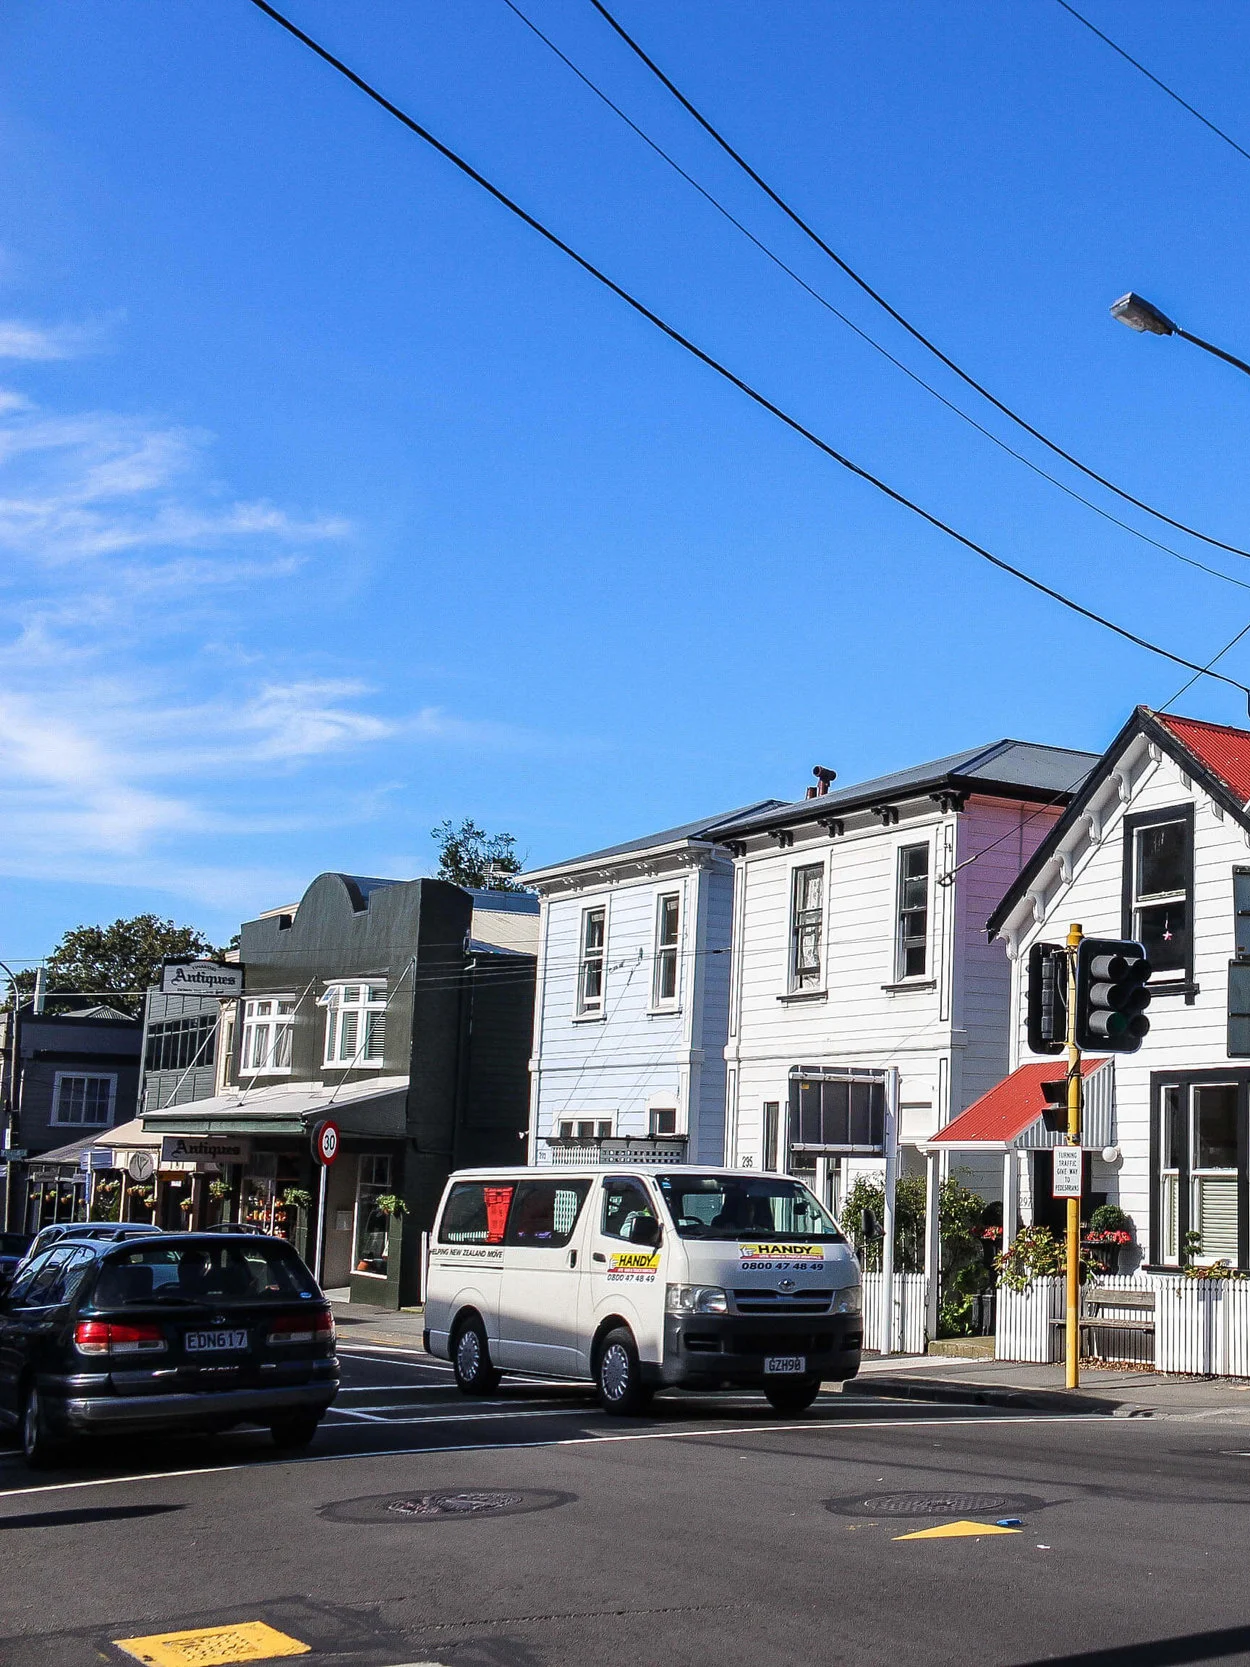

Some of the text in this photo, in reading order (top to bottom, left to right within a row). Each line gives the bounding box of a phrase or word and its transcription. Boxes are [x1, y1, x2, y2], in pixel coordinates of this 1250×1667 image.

[171, 968, 236, 988] Antiques
[324, 1135, 335, 1150] 30
[171, 1140, 240, 1159] Antiques
[462, 1249, 487, 1257] ZEALAND
[757, 1245, 813, 1254] HANDY
[618, 1255, 653, 1267] HANDY
[741, 1262, 772, 1270] 0800
[774, 1262, 790, 1270] 47
[809, 1263, 824, 1271] 49
[635, 1274, 645, 1282] 48
[645, 1275, 656, 1283] 49
